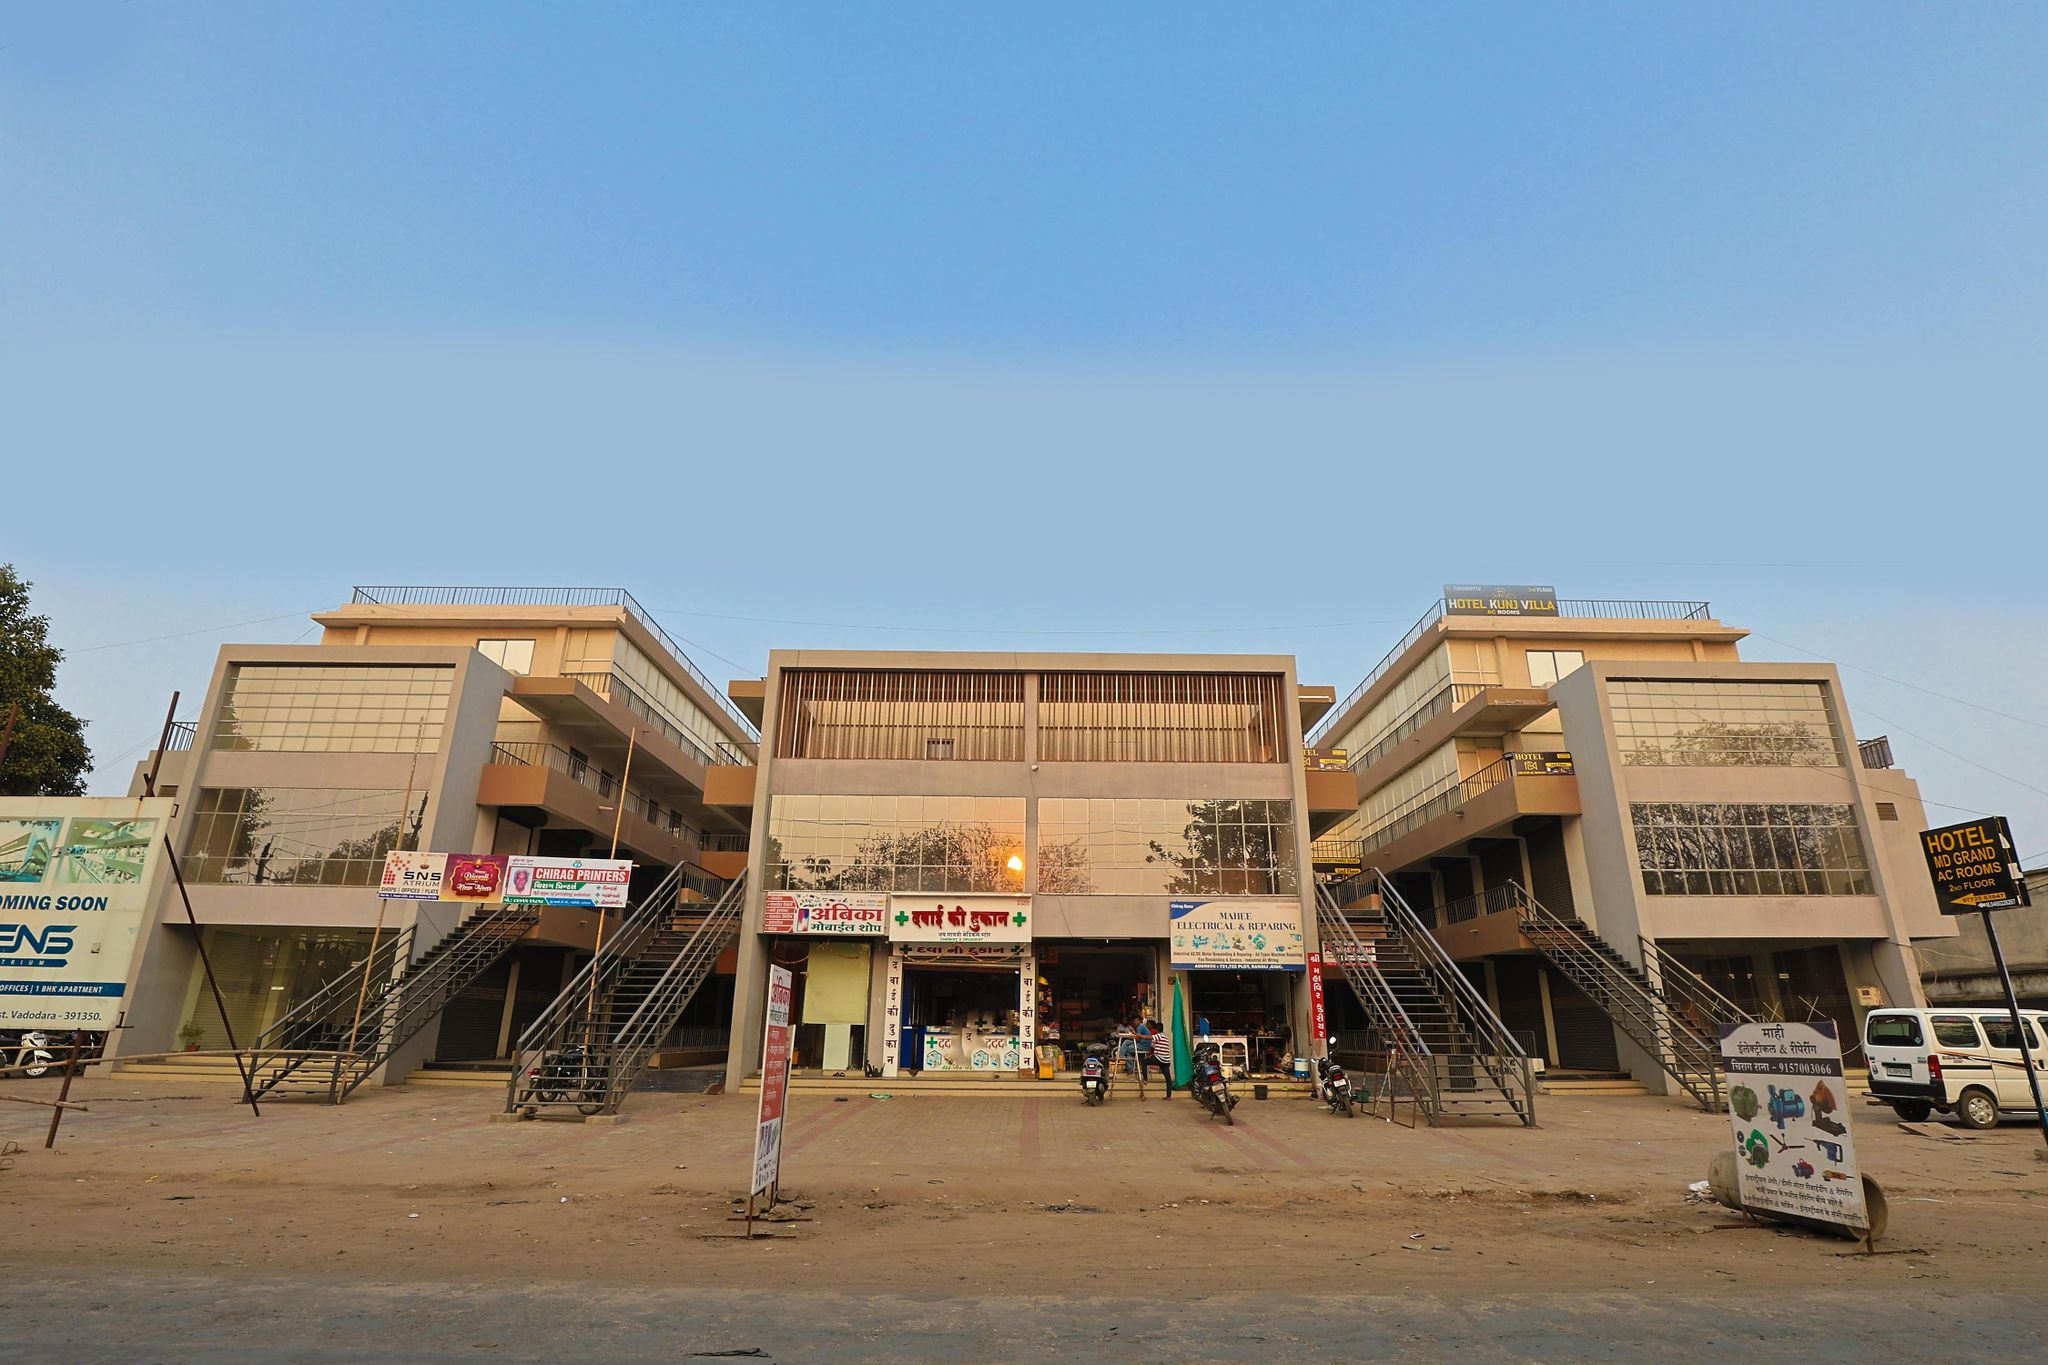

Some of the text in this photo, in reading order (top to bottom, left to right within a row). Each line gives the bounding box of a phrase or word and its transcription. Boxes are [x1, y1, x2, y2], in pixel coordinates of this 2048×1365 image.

[1449, 598, 1556, 610] HOTEL KUNJ VILLA
[1926, 826, 1993, 854] HOTEL
[1933, 846, 1996, 869] MD GRAND
[403, 871, 442, 880] SNS
[535, 868, 626, 882] CHIRAG PRINTERS
[1937, 862, 2002, 882] AC ROOMS
[1963, 878, 1996, 890] FLOOR
[55, 896, 109, 911] SOON
[811, 903, 884, 921] अंबिका
[911, 904, 1009, 932] दवाई की दुकान
[1219, 912, 1252, 920] MAHEE
[810, 921, 881, 932] मोबाईल शोप
[1177, 921, 1235, 930] ELECTRICAL
[1248, 922, 1296, 931] REPARING
[917, 945, 942, 954] દવા
[947, 944, 963, 954] ની
[1310, 954, 1320, 963] શ્રી
[41, 985, 57, 993] BHK
[11, 1011, 56, 1019] Vadodara
[64, 1011, 102, 1021] 391350.
[1761, 1023, 1785, 1041] माही
[1779, 1044, 1788, 1054] &
[1731, 1059, 1753, 1071] चिराग
[1753, 1062, 1769, 1072] राना
[1778, 1062, 1832, 1074] 9157003066
